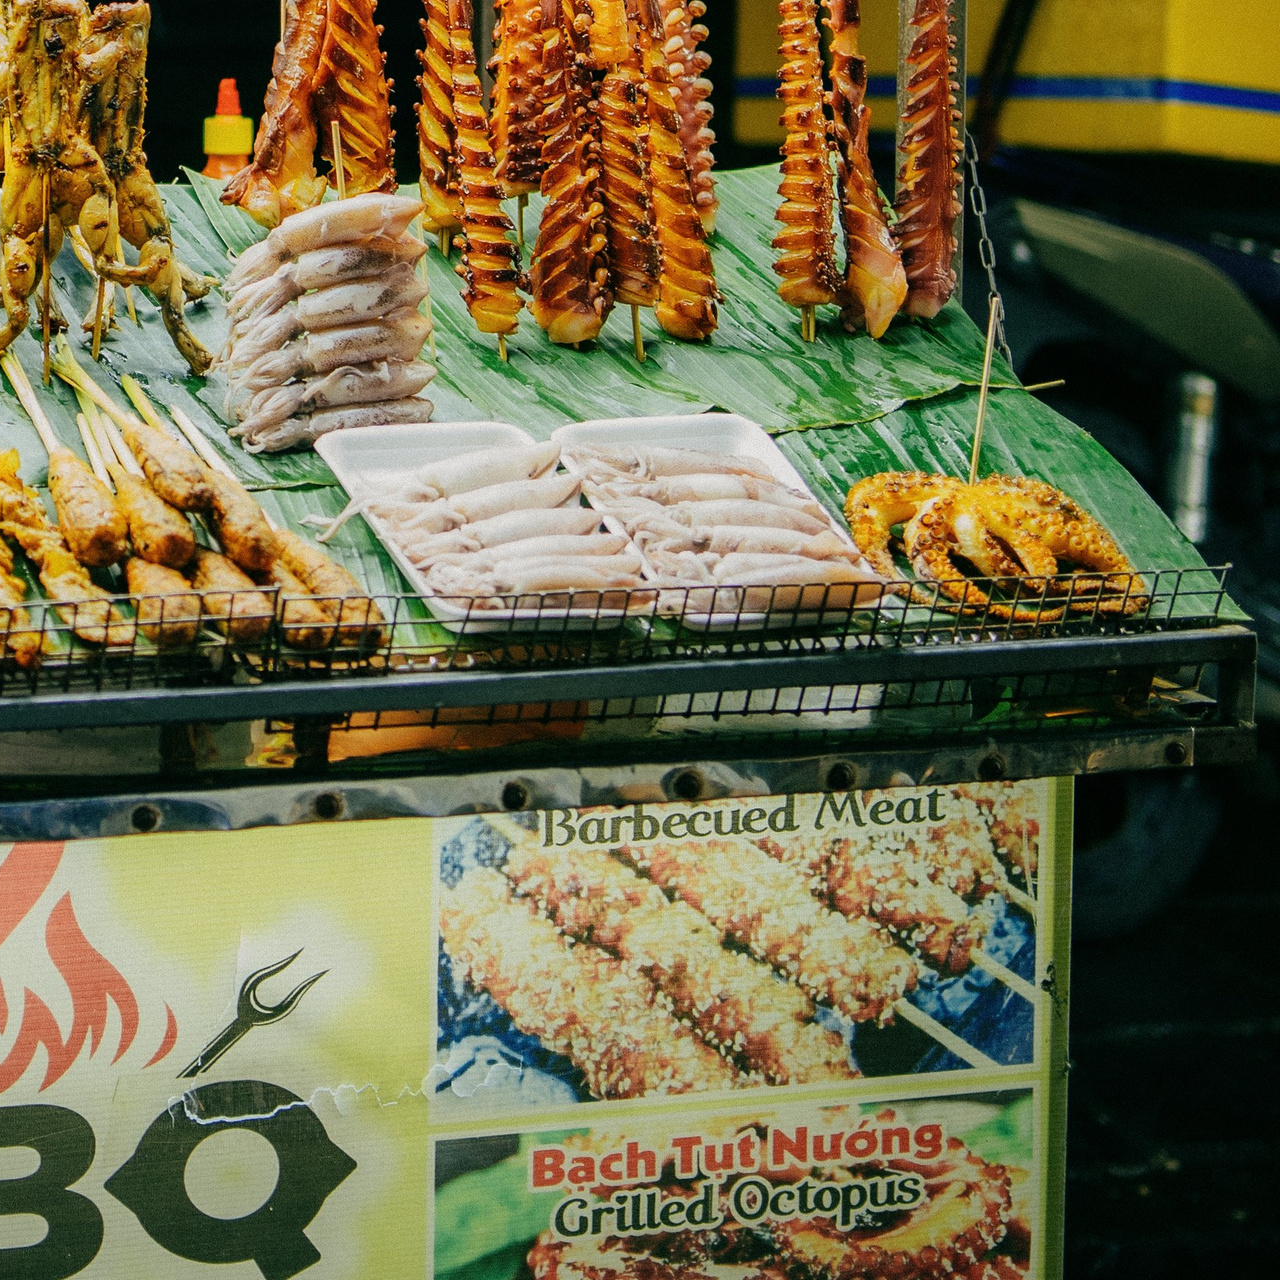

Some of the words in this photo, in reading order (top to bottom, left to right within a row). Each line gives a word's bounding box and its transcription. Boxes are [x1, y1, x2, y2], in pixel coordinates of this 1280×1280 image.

[540, 794, 801, 848] Barbecued
[815, 787, 947, 830] Meat
[532, 1140, 657, 1193] Bạch
[671, 1129, 757, 1180] Tụt
[772, 1119, 943, 1165] Nướng
[554, 1183, 718, 1238] Grilled
[733, 1175, 921, 1226] Octopus
